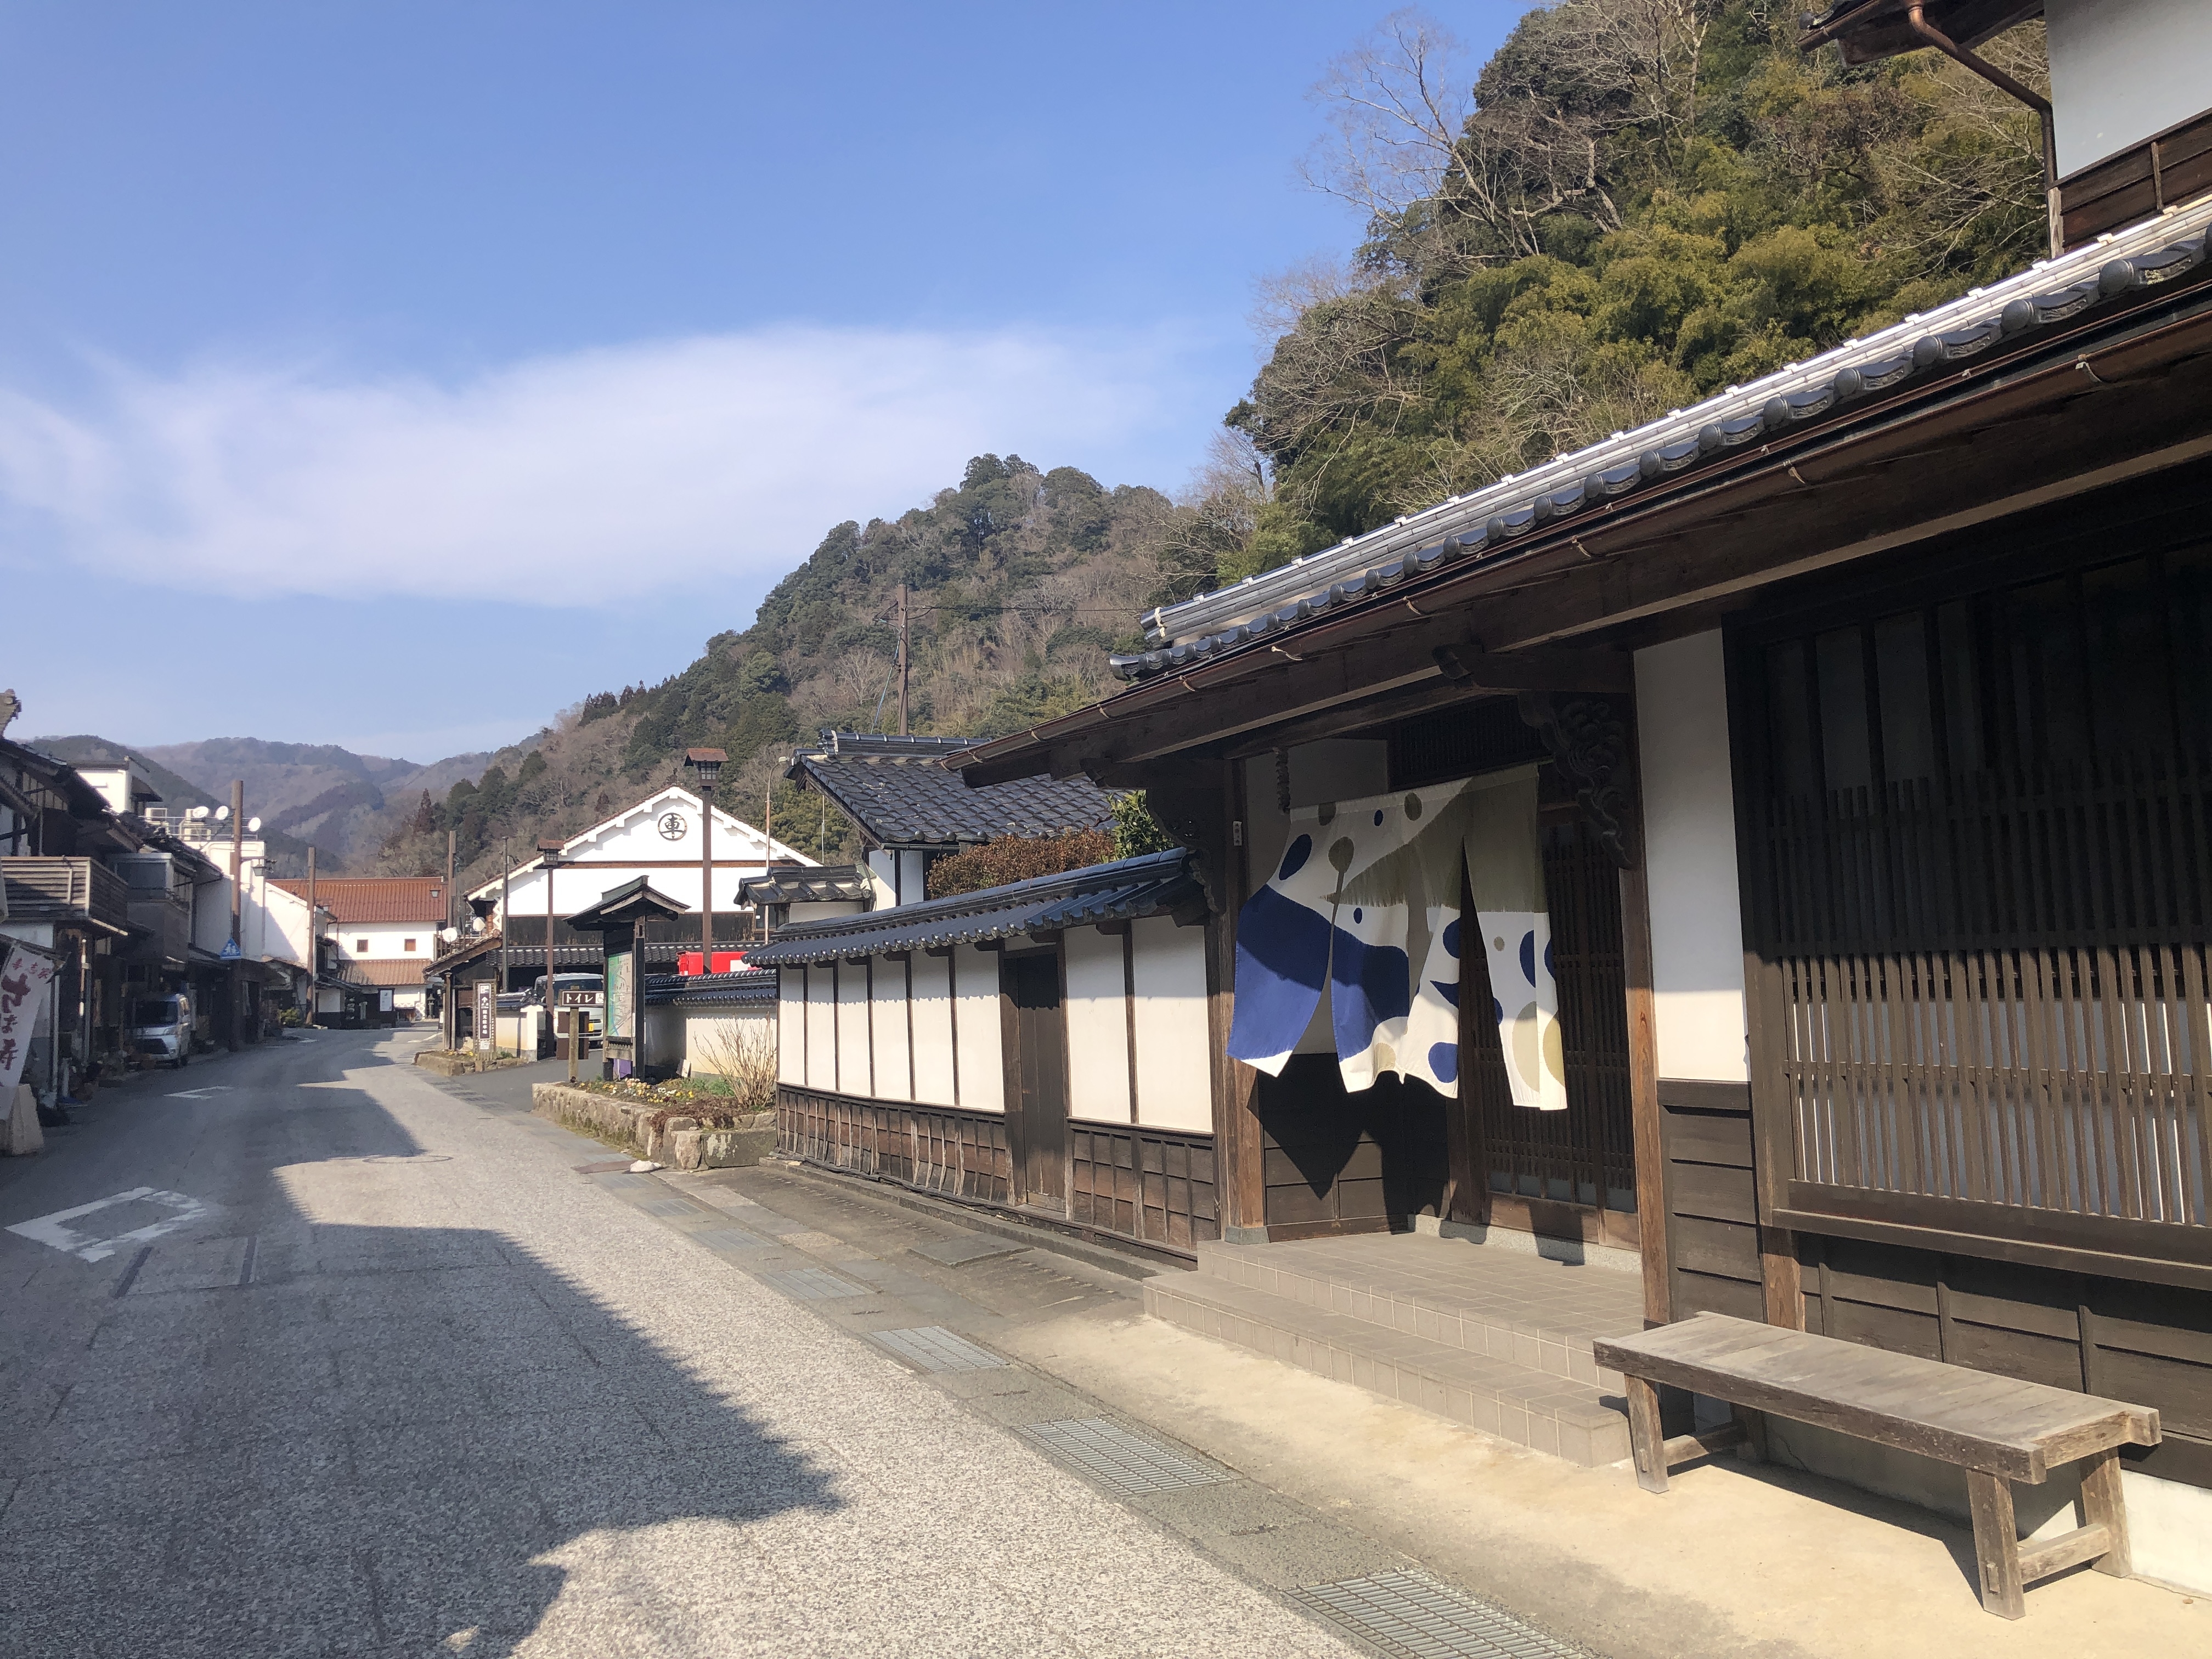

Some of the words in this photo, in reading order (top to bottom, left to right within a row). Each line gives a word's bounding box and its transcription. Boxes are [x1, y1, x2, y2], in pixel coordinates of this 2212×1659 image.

[659, 813, 686, 840] 車
[566, 993, 594, 1003] トイレ
[0, 973, 31, 1086] さば寿
